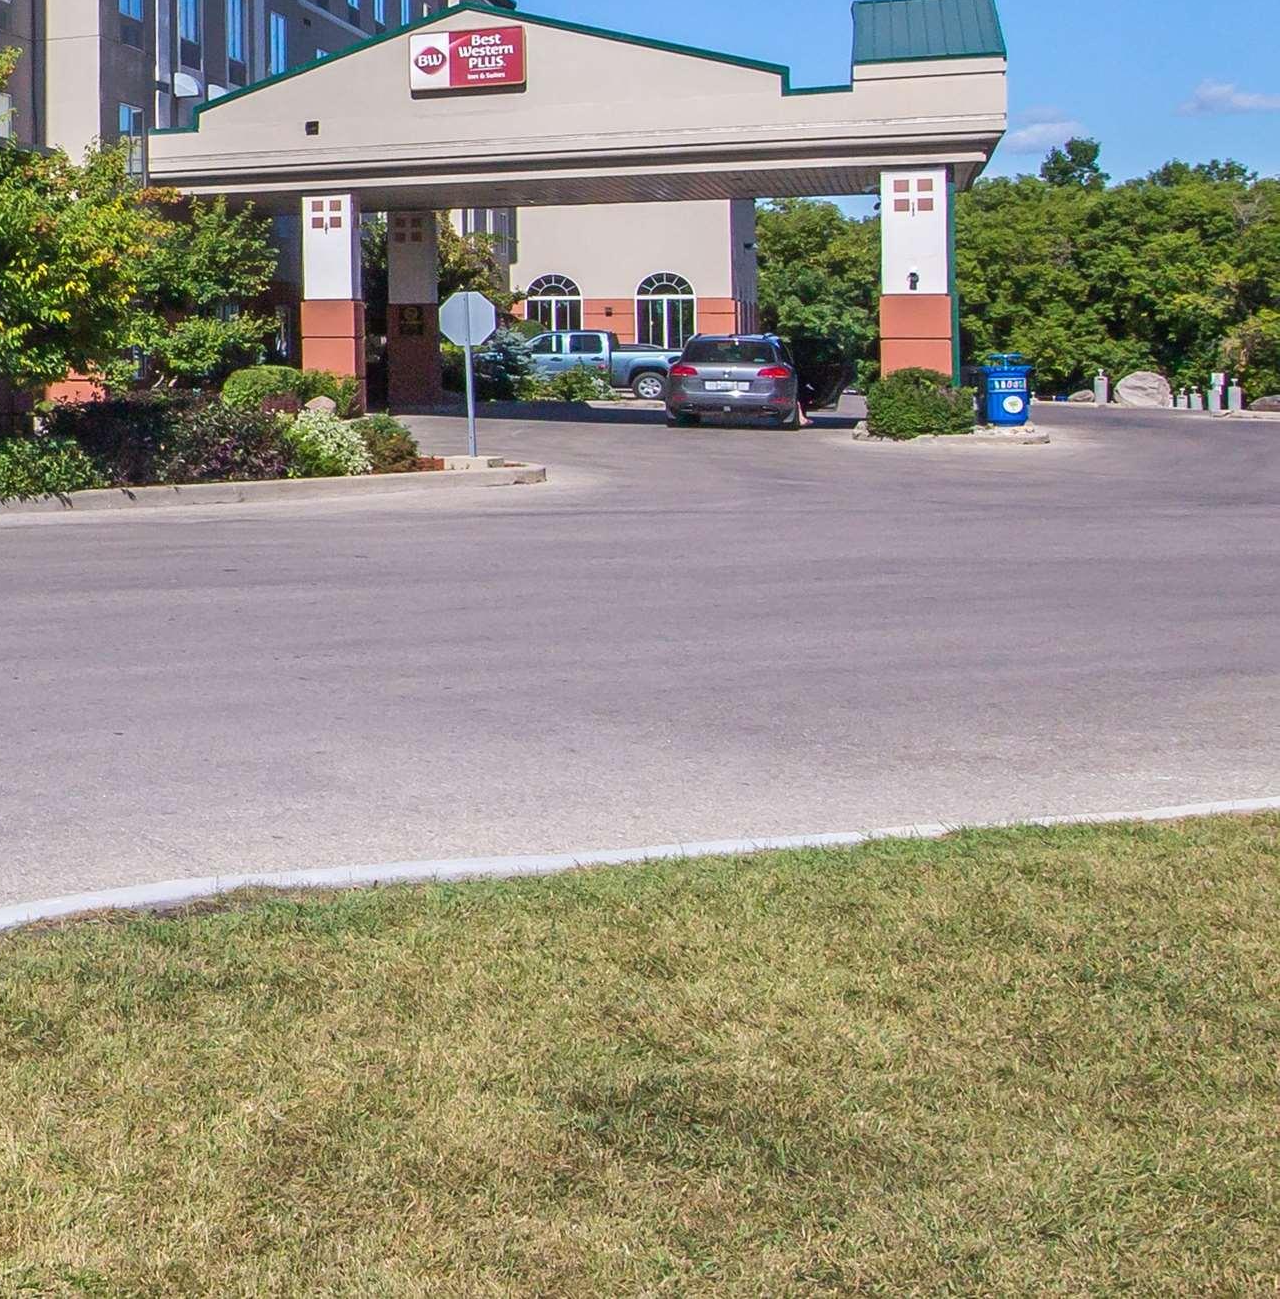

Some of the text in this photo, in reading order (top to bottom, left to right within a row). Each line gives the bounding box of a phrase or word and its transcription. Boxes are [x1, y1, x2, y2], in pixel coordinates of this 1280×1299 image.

[471, 34, 501, 46] Best
[458, 45, 514, 58] Western
[418, 54, 442, 66] BW
[469, 57, 504, 69] PLUS
